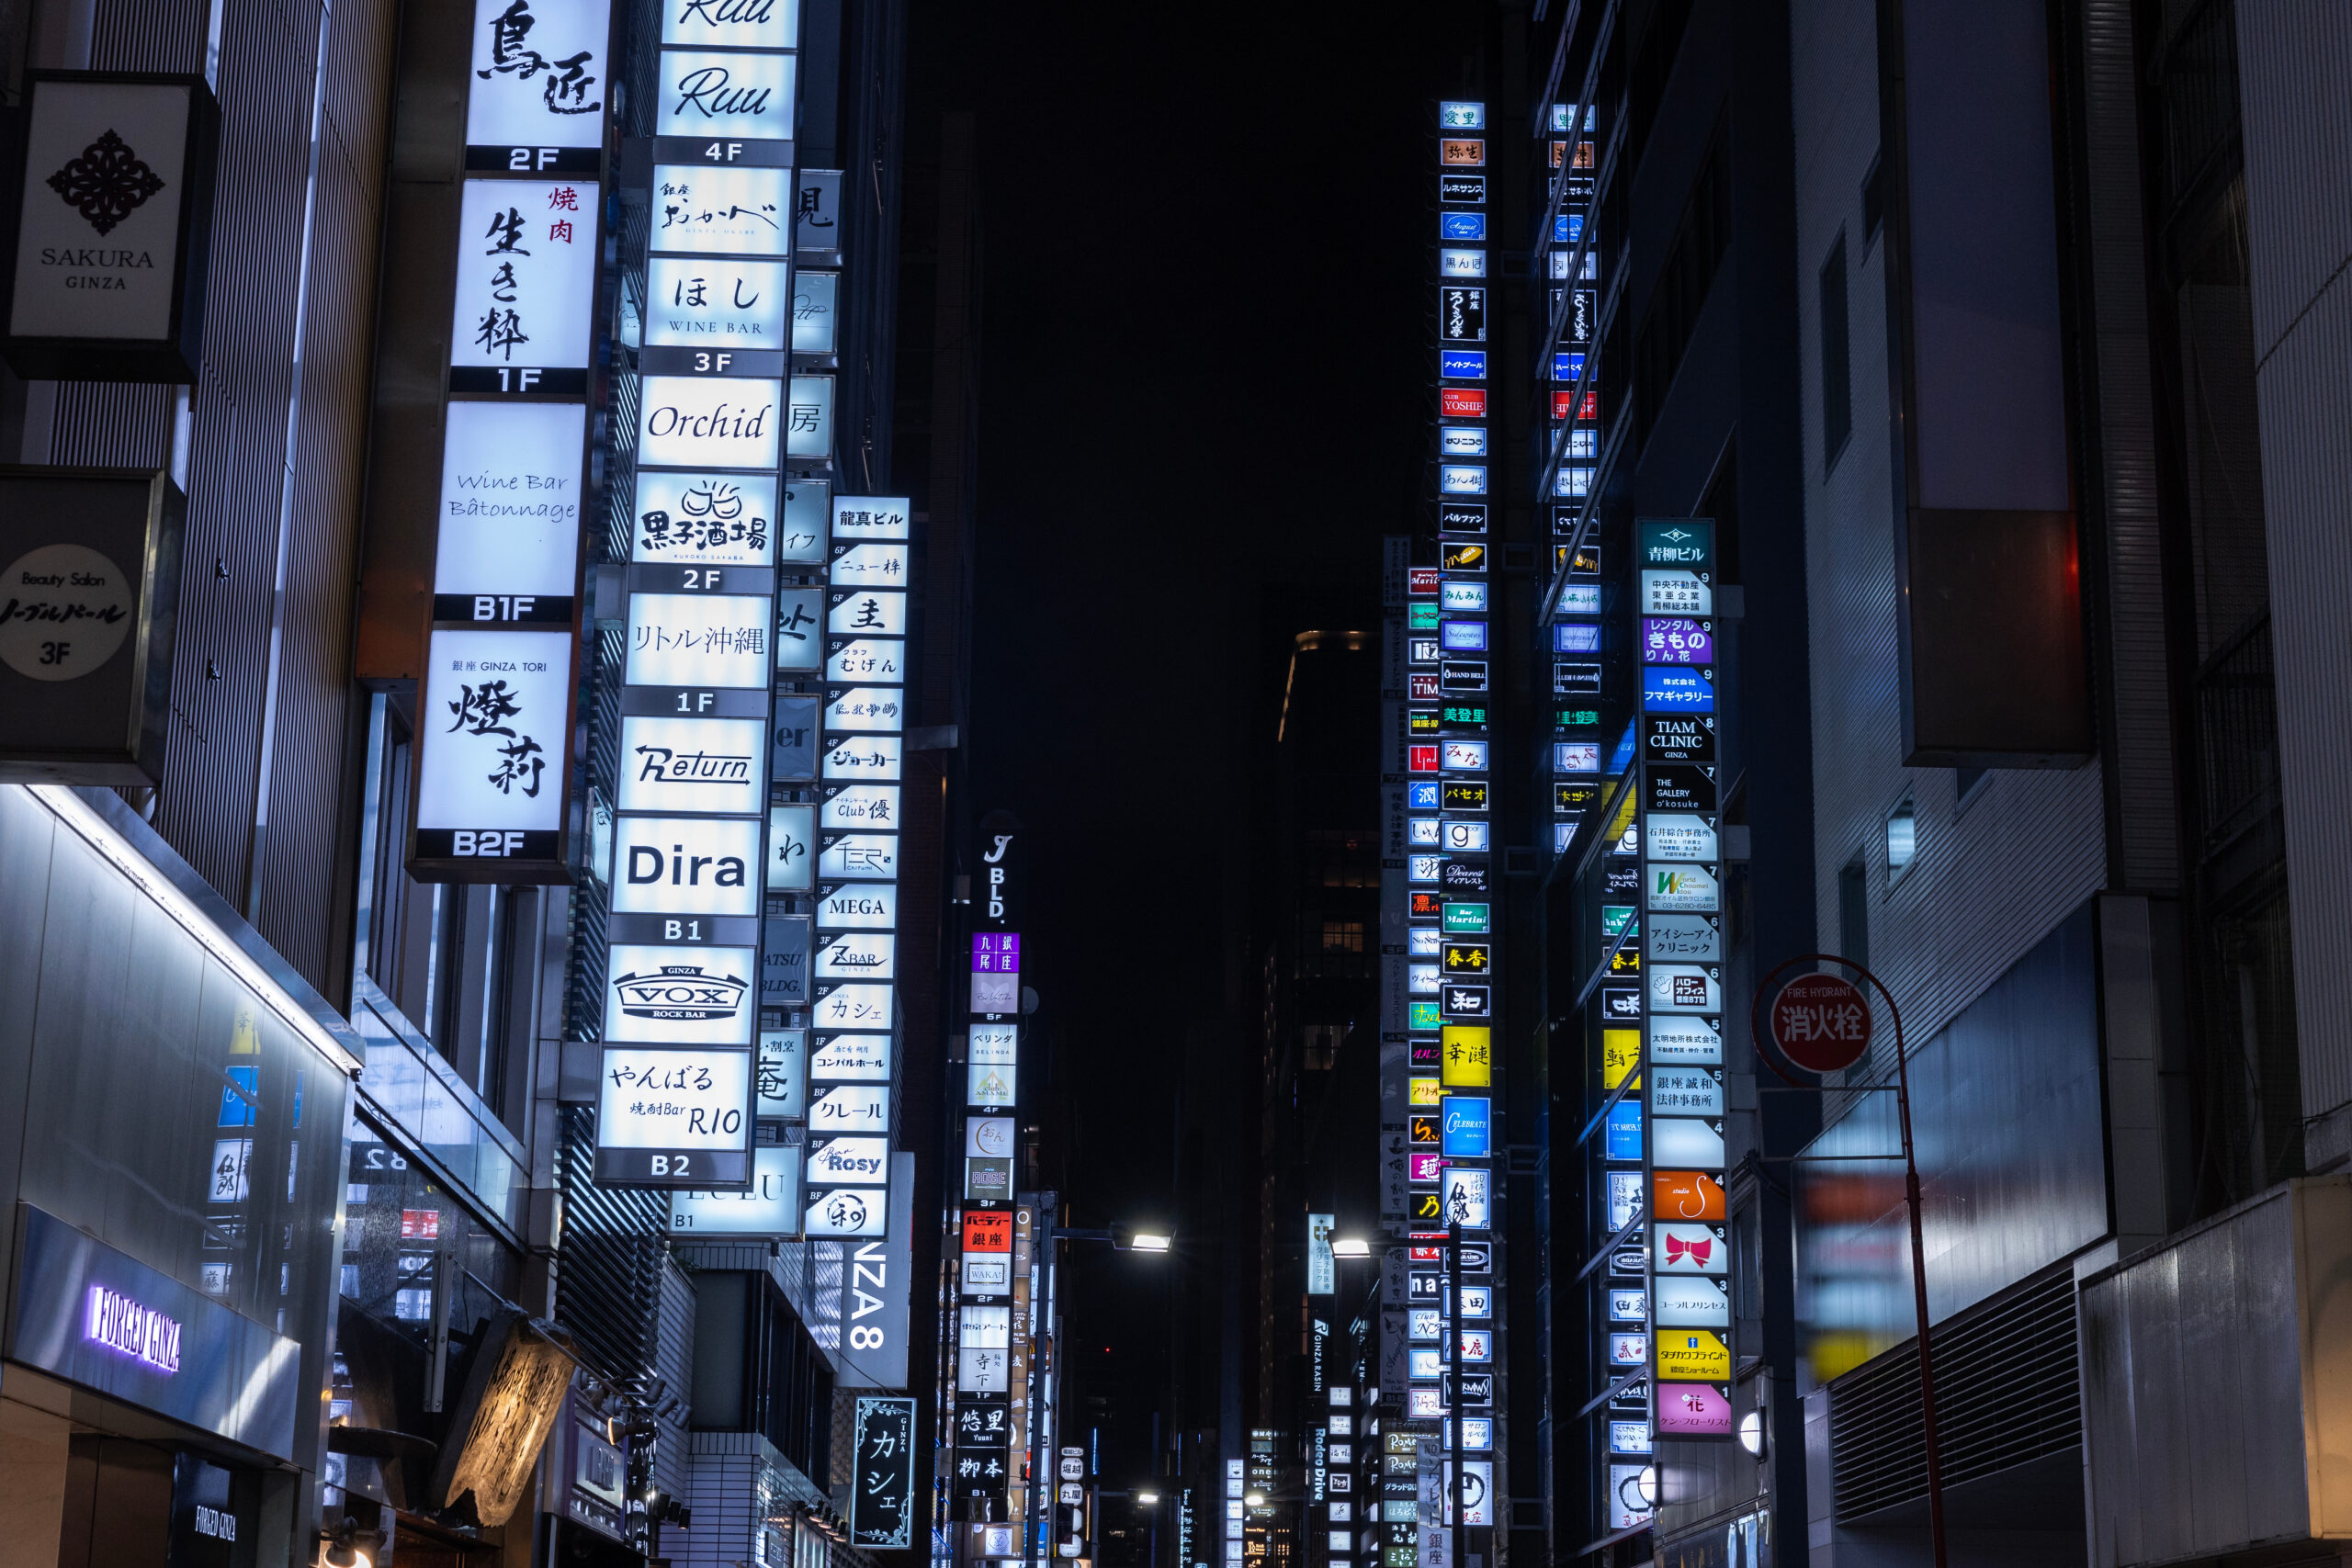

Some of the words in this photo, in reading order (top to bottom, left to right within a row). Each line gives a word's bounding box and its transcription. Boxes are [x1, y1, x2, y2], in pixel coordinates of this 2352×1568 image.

[477, 0, 602, 115] 鳥匠
[1444, 110, 1476, 126] 愛里
[705, 142, 743, 162] 4F
[1447, 144, 1478, 160] 弥生
[509, 149, 560, 171] 2F
[660, 183, 691, 196] 銀座
[1442, 184, 1484, 194] ルネサンス
[548, 186, 580, 245] 焼肉
[41, 247, 154, 269] SAKURA
[65, 276, 127, 291] GINZA
[474, 208, 531, 361] 生き粋
[674, 277, 760, 310] ほし
[1469, 290, 1481, 310] 銀座
[669, 321, 717, 333] WINE
[727, 322, 763, 334] BAR
[694, 353, 732, 372] 3F
[498, 370, 542, 392] 1F
[1444, 400, 1484, 412] YOSHIE
[648, 403, 773, 439] Orchid
[789, 403, 822, 433] 房
[458, 472, 518, 491] Wine
[526, 474, 570, 491] Bar
[1444, 473, 1483, 486] あん樹
[449, 498, 576, 523] Bâtonnage
[839, 511, 903, 526] 龍真ビル
[1443, 513, 1484, 524] パルファン
[640, 510, 768, 551] 黒子酒場
[1648, 547, 1705, 562] 青柳ビル
[21, 571, 65, 589] Beauty
[71, 571, 106, 587] Salon
[683, 570, 720, 589] 2F
[1652, 580, 1700, 590] 中央不動産
[1701, 572, 1710, 583] 9
[1444, 591, 1484, 601] みんみん
[1652, 591, 1700, 601] 東亜企業
[473, 596, 536, 621] B1F
[1653, 602, 1700, 612] 青柳総本舗
[1650, 619, 1694, 631] レンタル
[1702, 621, 1712, 632] 9
[634, 626, 765, 655] リトル沖縄
[1648, 632, 1706, 649] きもの
[40, 642, 71, 665] 3F
[1645, 649, 1690, 662] りん花
[452, 660, 477, 671] 銀座
[481, 661, 516, 671] GINZA
[522, 661, 548, 672] TORI
[840, 658, 897, 672] むげん
[1663, 678, 1697, 686] 株式会社
[1703, 669, 1713, 680] 9
[677, 693, 714, 712] 1F
[1645, 691, 1713, 702] フマギャラリー
[1442, 707, 1487, 723] 美登里
[1705, 717, 1714, 728] 8
[1656, 721, 1696, 734] TIAM
[1650, 736, 1702, 749] CLINIC
[831, 750, 898, 767] ジョーカー
[1446, 745, 1479, 766] みな
[634, 745, 752, 785] Return
[1706, 766, 1715, 777] 7
[1444, 788, 1486, 801] パセオ
[1657, 789, 1690, 797] GALLERY
[838, 805, 865, 818] Club
[868, 799, 890, 821] 優
[1708, 817, 1716, 827] 7
[1648, 828, 1712, 838] 石井綜合事務所
[453, 830, 525, 857] B2F
[983, 835, 1013, 863] J
[628, 844, 746, 887] Dira
[1445, 864, 1485, 878] Dearest
[1709, 865, 1718, 876] 7
[829, 898, 886, 915] MEGA
[1446, 916, 1487, 924] Martini
[1711, 917, 1718, 927] 6
[664, 919, 702, 940] B1
[1651, 928, 1713, 941] アイシーアイ
[979, 935, 991, 970] 九尾
[1001, 935, 1012, 970] 銀座
[1656, 942, 1711, 953] クリニック
[1446, 949, 1487, 967] 春香
[667, 966, 696, 976] GINZA
[1710, 967, 1719, 978] 6
[1676, 978, 1699, 987] ハロー
[628, 987, 729, 1005] VOX
[1676, 987, 1705, 995] オフィス
[1787, 987, 1807, 998] FIRE
[1810, 987, 1851, 998] HYDRANT
[1450, 989, 1481, 1010] 和
[1676, 995, 1706, 1004] 銀座8丁目
[653, 1010, 683, 1019] ROCK
[684, 1010, 707, 1020] BAR
[831, 999, 882, 1020] カシェ
[1711, 1020, 1720, 1030] 5
[1781, 1004, 1864, 1042] 消火栓
[974, 1034, 1013, 1043] ベリンダ
[1445, 1042, 1489, 1067] 華漣
[817, 1058, 885, 1068] コンパルホール
[608, 1065, 713, 1090] やんばる
[1657, 1077, 1713, 1089] 銀座誠和
[1713, 1070, 1723, 1081] 5
[813, 1088, 826, 1097] BF
[1657, 1093, 1713, 1107] 法律事務所
[629, 1101, 686, 1117] 焼酎Bar
[820, 1102, 884, 1119] クレール
[688, 1107, 741, 1135] RIO
[1446, 1111, 1487, 1134] CELEBRATE
[1713, 1122, 1723, 1133] 4
[650, 1155, 690, 1177] B2
[828, 1155, 882, 1175] Rosy
[1714, 1174, 1724, 1185] 4
[674, 1214, 694, 1227] B1
[966, 1215, 1011, 1226] バーディー
[972, 1233, 1002, 1247] 銀座
[1716, 1227, 1724, 1238] 3
[1719, 1280, 1727, 1292] 3
[1659, 1301, 1726, 1310] コーラルプリンセス
[96, 1286, 148, 1357] FORGED
[146, 1311, 182, 1372] GINZA
[1314, 1335, 1322, 1362] GINZA
[1660, 1350, 1727, 1359] タチカワブラインド
[975, 1353, 991, 1387] 寺下
[1670, 1366, 1720, 1374] 銀座ショールーム
[1314, 1363, 1322, 1393] RASIN
[960, 1408, 1005, 1432] 悠里
[1660, 1417, 1732, 1427] ケン・フローリスト
[1315, 1427, 1326, 1467] Rodeo
[866, 1429, 897, 1509] カシェ
[1314, 1468, 1326, 1502] Drive
[971, 1489, 986, 1497] B1
[195, 1505, 219, 1537] FORGED
[219, 1512, 236, 1542] GINZA
[1428, 1533, 1443, 1565] 銀座
